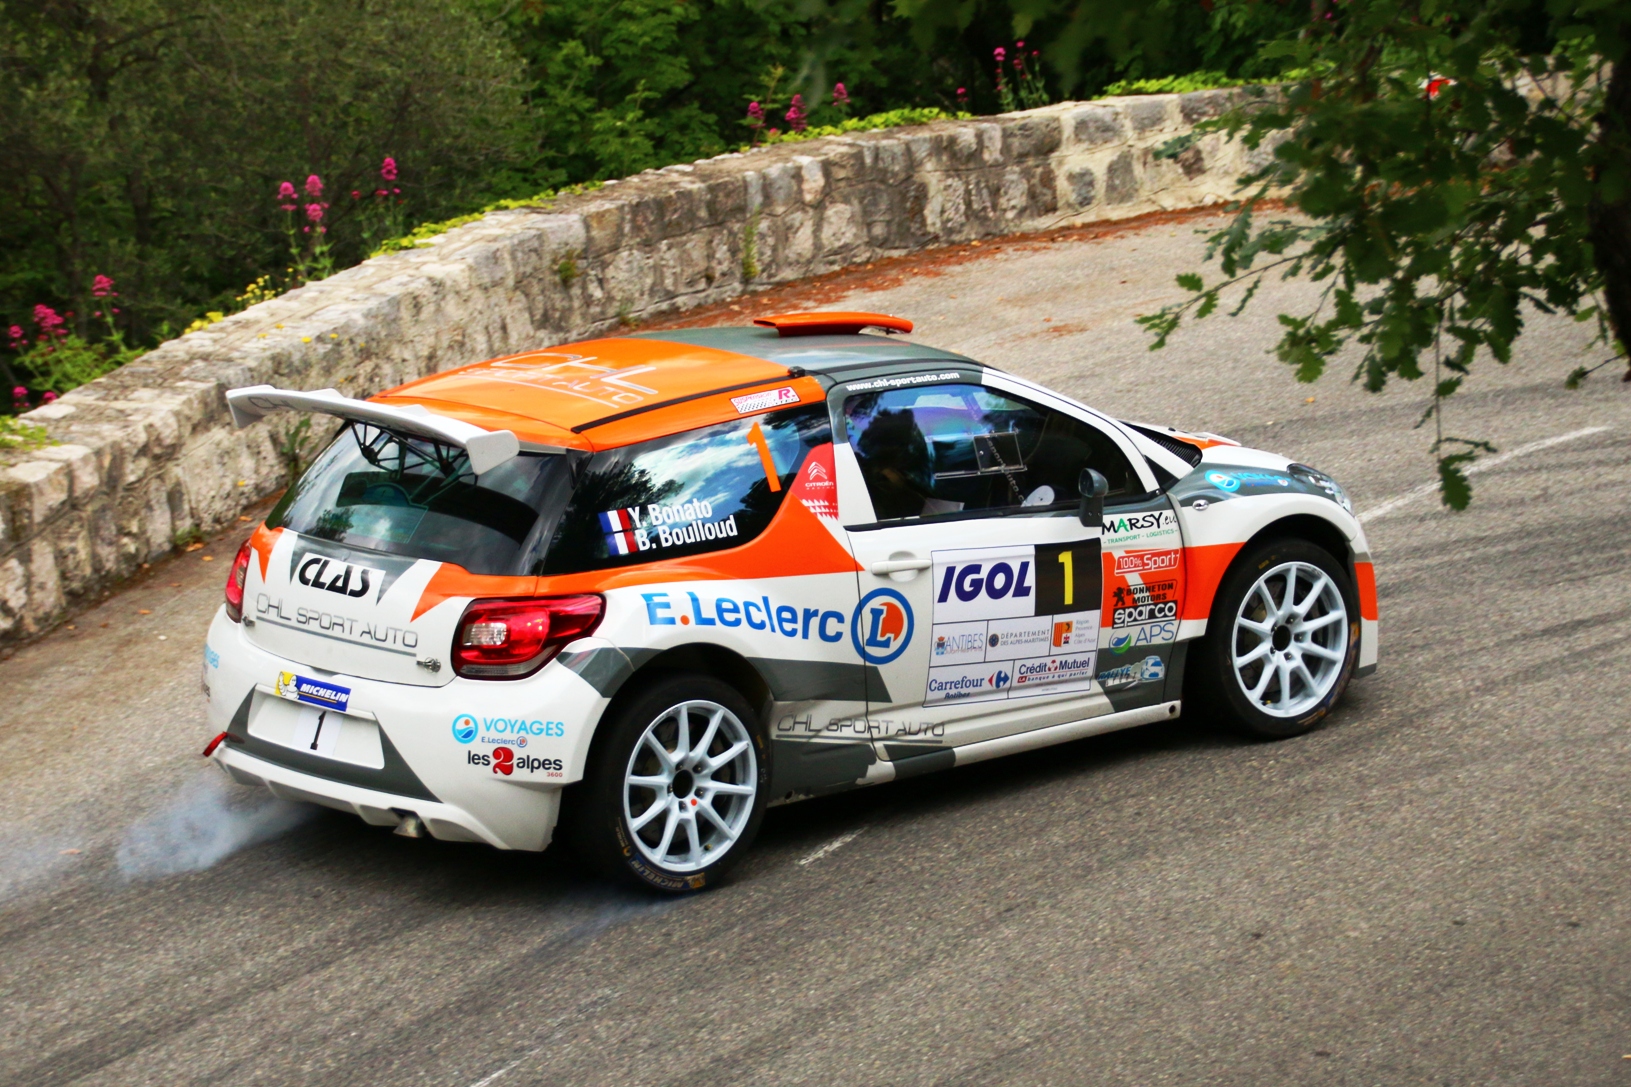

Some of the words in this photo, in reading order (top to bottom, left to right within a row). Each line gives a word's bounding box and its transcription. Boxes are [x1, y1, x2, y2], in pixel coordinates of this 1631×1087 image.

[846, 372, 960, 391] www.chl-sportauto.com
[746, 421, 782, 492] 1
[628, 506, 652, 528] Y.
[650, 497, 713, 525] Bonato
[637, 530, 657, 551] B.
[660, 515, 738, 547] Boulloud
[1107, 533, 1141, 545] TRANSPORT
[1146, 529, 1175, 539] LOGISTICS
[1119, 555, 1143, 569] 100%
[1143, 551, 1180, 570] Sport
[298, 557, 371, 598] CLAS
[937, 560, 1032, 604] IGOL
[1058, 550, 1073, 606] 1
[1126, 582, 1174, 596] BONNETON
[1132, 593, 1167, 605] MOTORS
[256, 592, 291, 621] CHL
[296, 606, 358, 637] SPORT
[359, 623, 418, 649] AUTO
[641, 591, 845, 643] E.Leclerc
[1114, 602, 1177, 625] sparco
[946, 634, 984, 649] ANTIBES
[1000, 629, 1050, 640] DÉPARTEMENT
[1134, 622, 1174, 646] APS
[1018, 662, 1048, 676] Crédit
[1058, 657, 1091, 671] Mutuel
[300, 683, 350, 703] MICHELIN
[928, 675, 985, 693] Carrefour
[310, 711, 327, 750] 1
[483, 717, 565, 738] VOYAGES
[777, 714, 820, 732] CHL
[825, 715, 896, 735] SPORT
[895, 720, 946, 738] AUTO
[481, 736, 516, 746] E.Leclerc
[467, 750, 490, 767] les
[492, 746, 514, 776] 2
[516, 755, 563, 773] alpes
